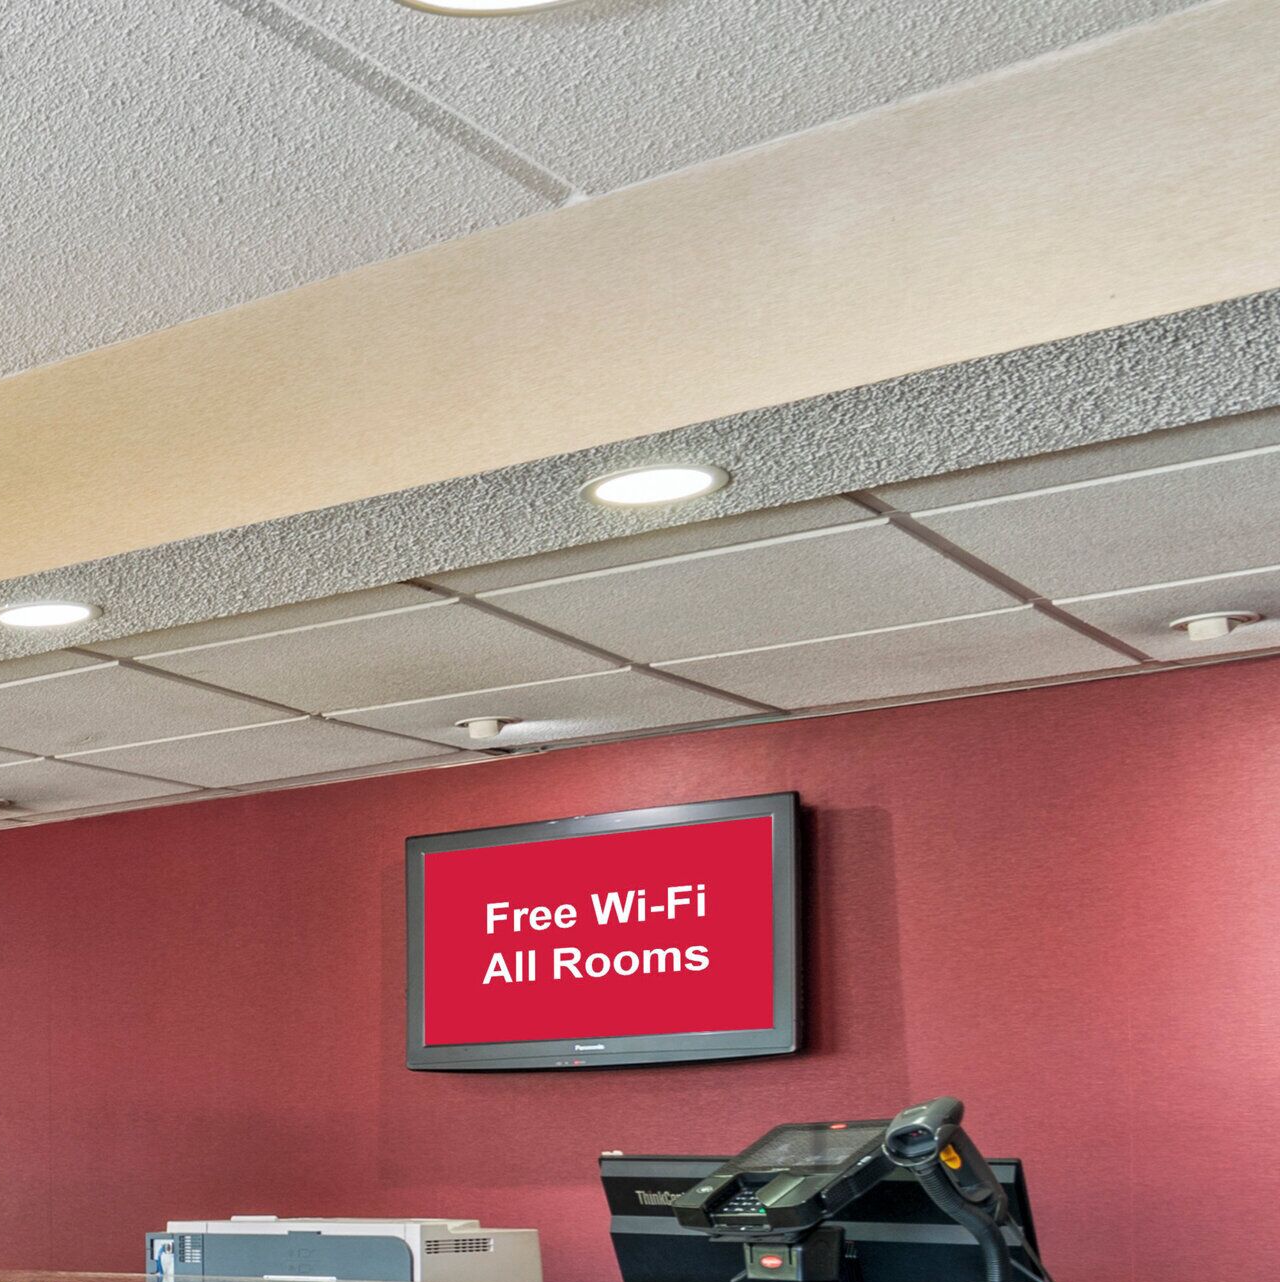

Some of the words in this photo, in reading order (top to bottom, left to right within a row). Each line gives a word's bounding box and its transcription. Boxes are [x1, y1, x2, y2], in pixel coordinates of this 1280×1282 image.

[486, 901, 578, 935] Free
[591, 884, 706, 926] Wi-Fi
[482, 950, 537, 985] All
[553, 945, 710, 980] Rooms
[635, 1190, 685, 1206] ThinkCe
